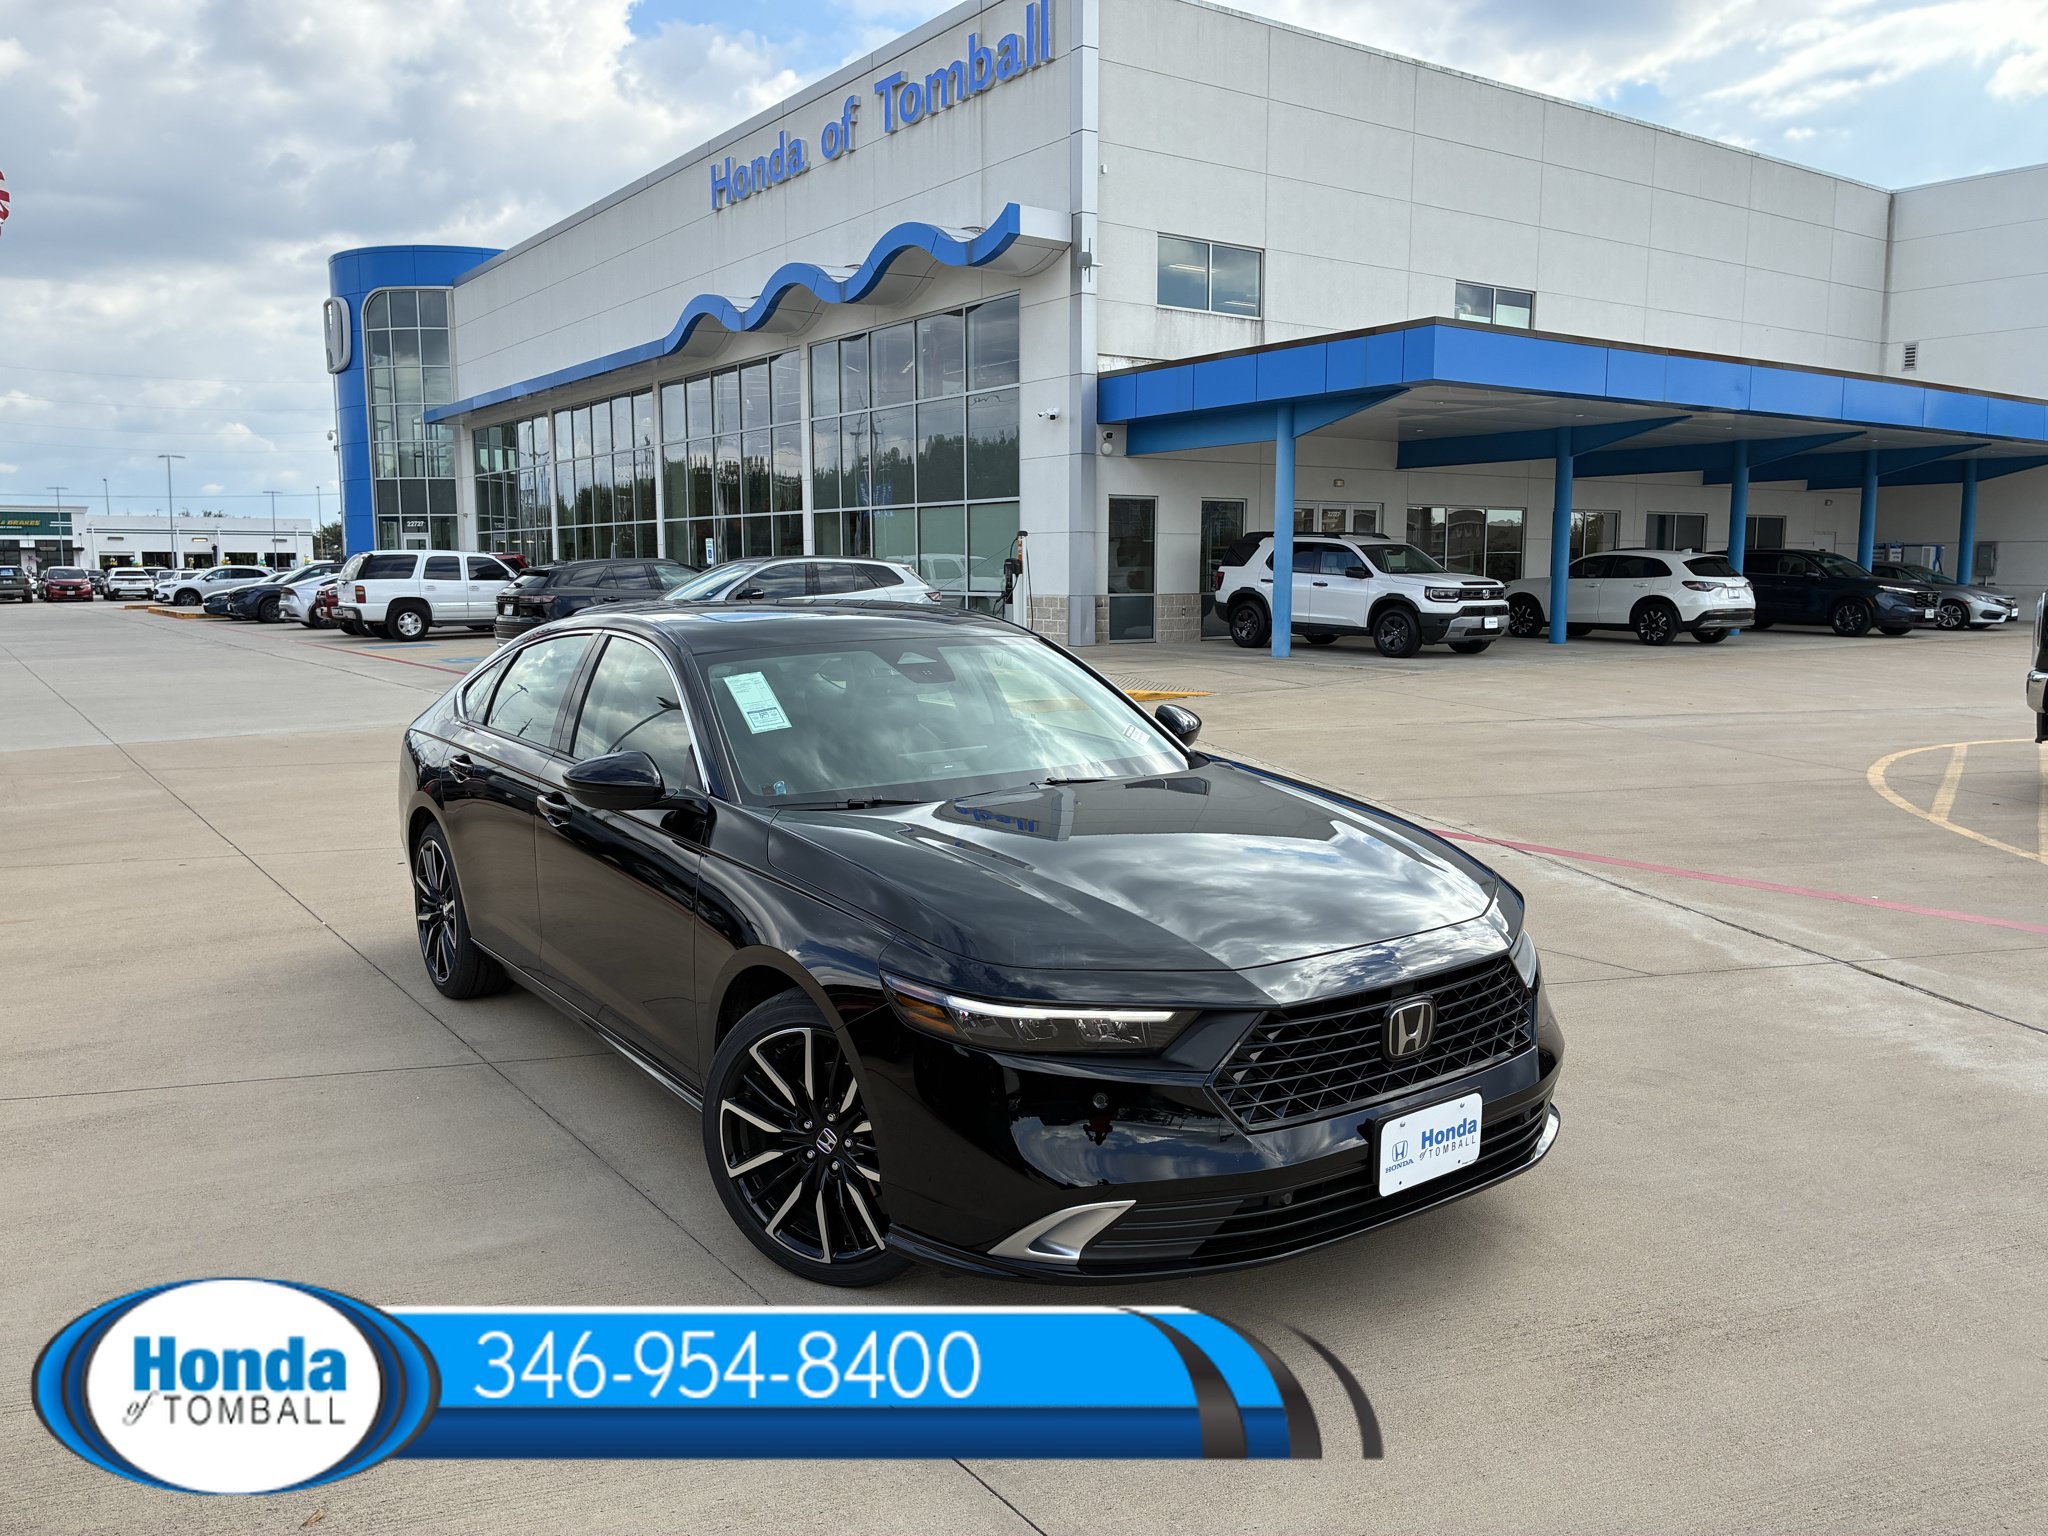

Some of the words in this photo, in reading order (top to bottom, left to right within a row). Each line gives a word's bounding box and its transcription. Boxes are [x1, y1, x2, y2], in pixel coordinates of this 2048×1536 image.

[710, 130, 810, 210] Honda
[821, 95, 861, 160] of
[874, 0, 1054, 133] Tomball
[1419, 1148, 1429, 1160] of
[1429, 1135, 1476, 1158] TOMBALL
[1421, 1118, 1477, 1149] Honda
[1385, 1158, 1414, 1173] HONDA
